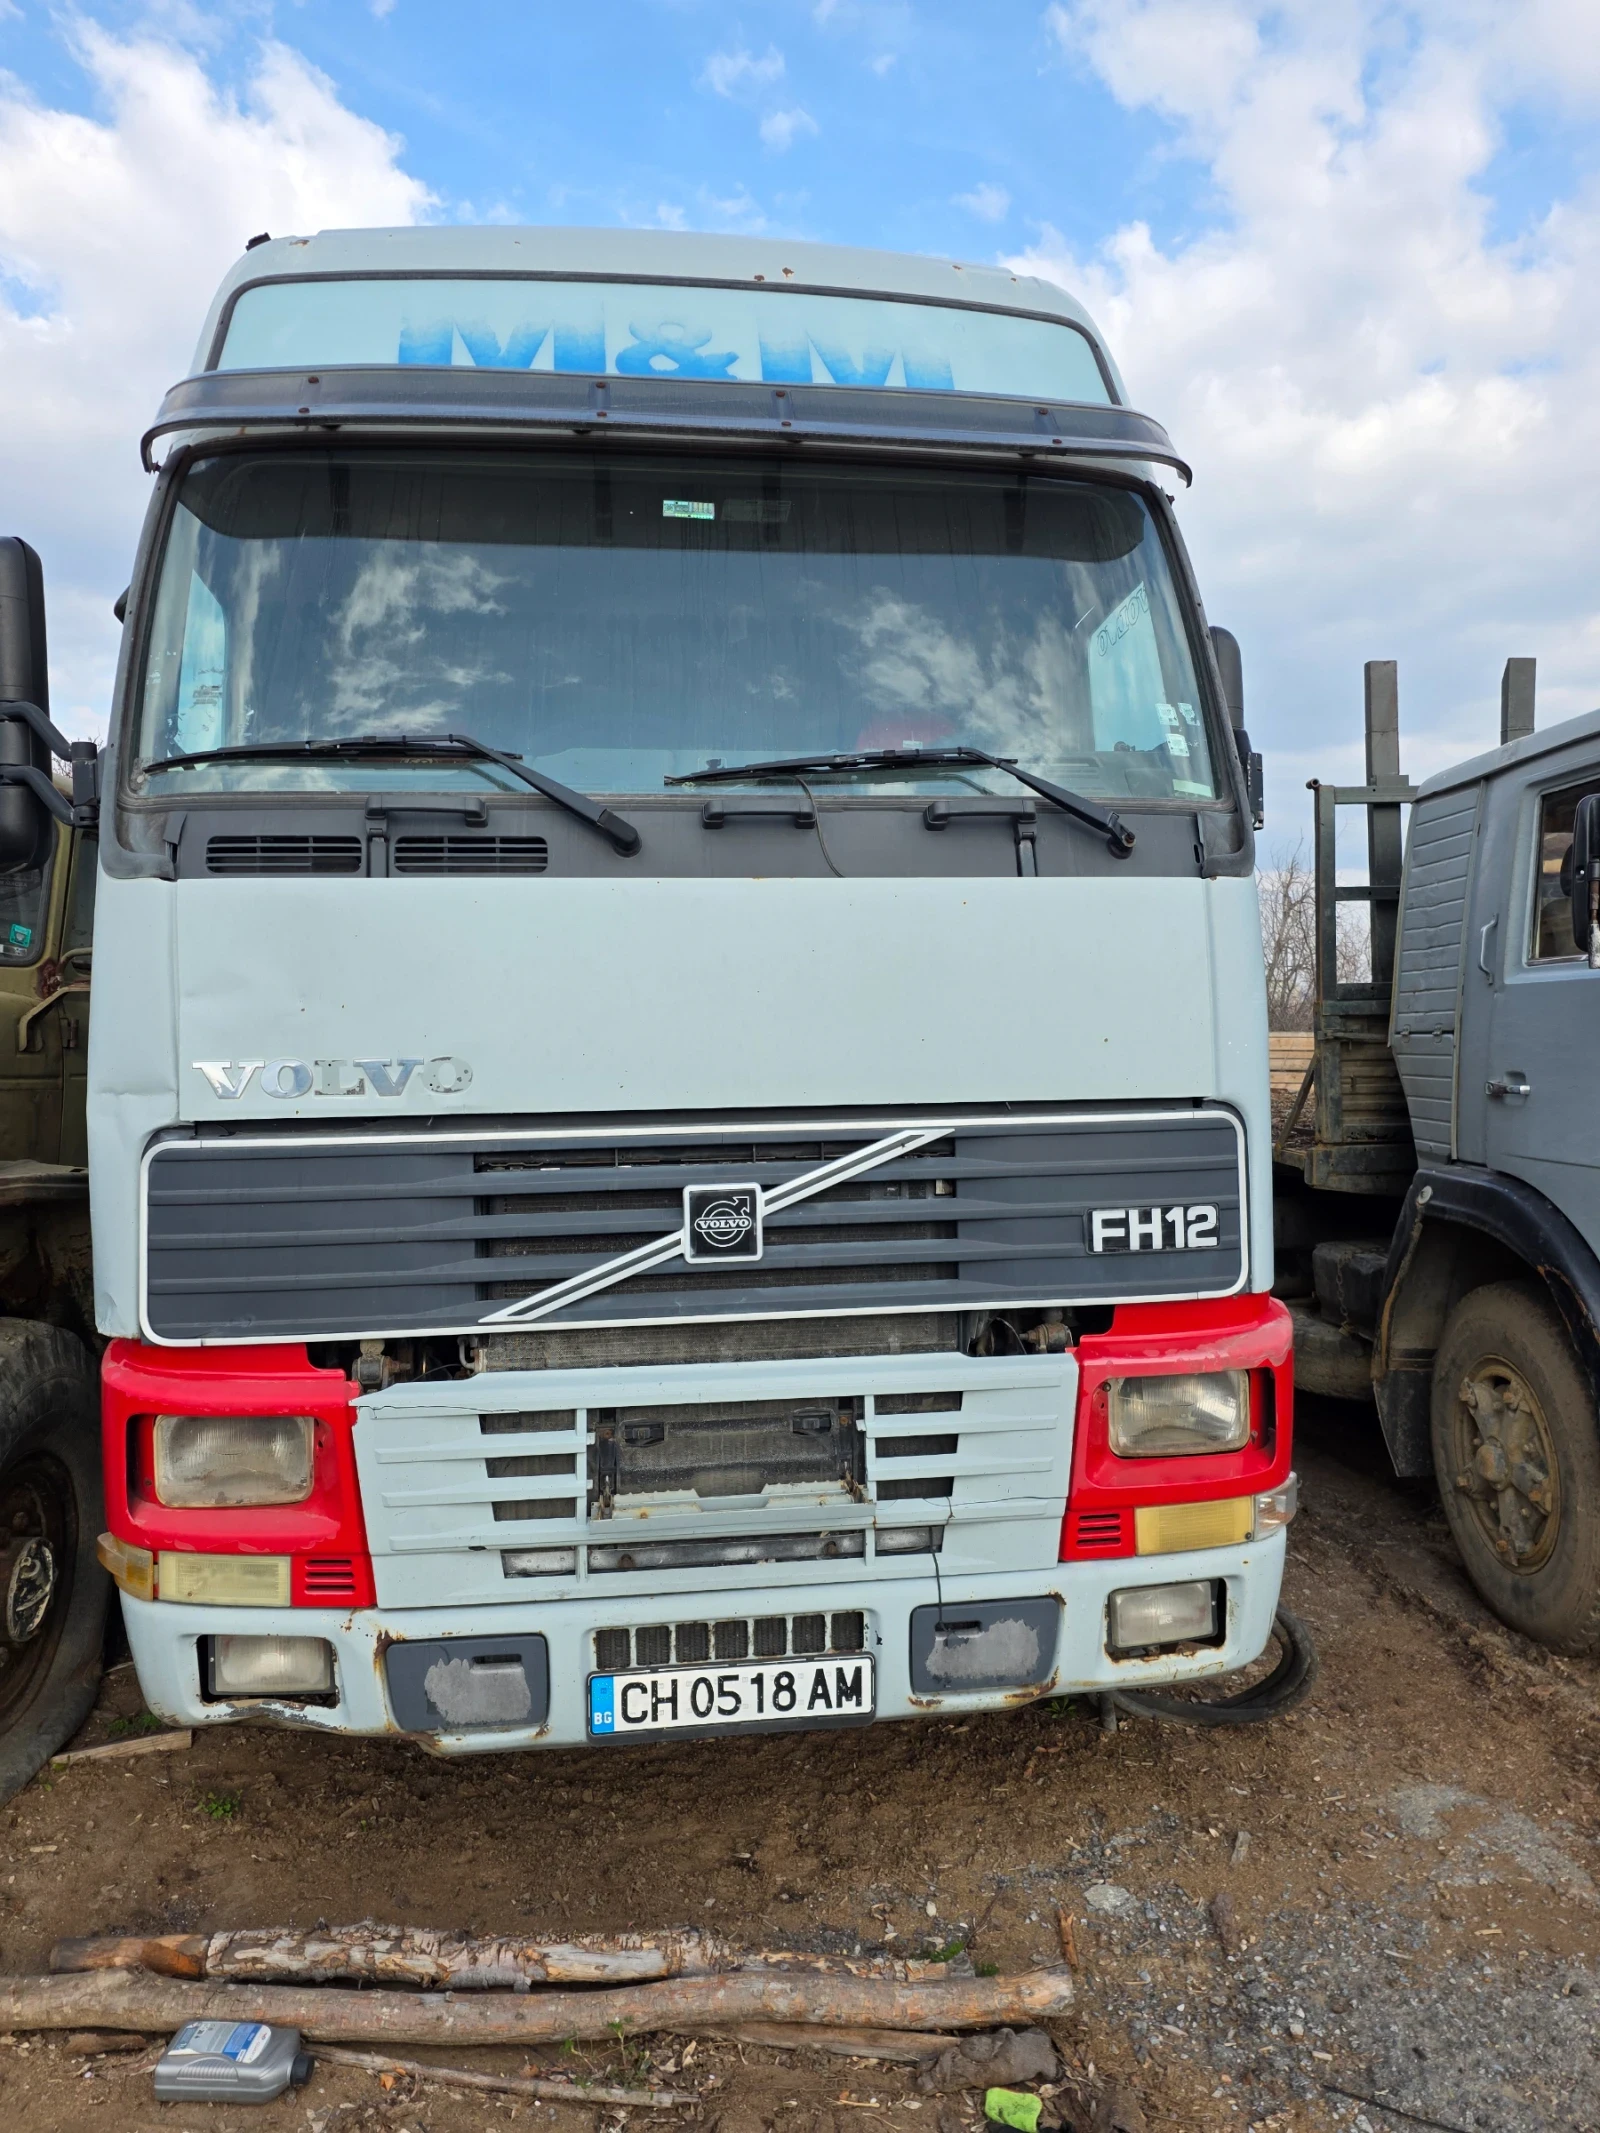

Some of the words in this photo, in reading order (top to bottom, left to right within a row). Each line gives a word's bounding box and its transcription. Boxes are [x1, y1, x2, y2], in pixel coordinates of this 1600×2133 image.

[398, 306, 956, 391] M&M
[192, 1056, 474, 1099] VOLVO
[697, 1218, 749, 1229] VOLVO
[1092, 1205, 1218, 1252] FH12
[621, 1678, 678, 1724] CH
[690, 1671, 797, 1718] 0518
[807, 1665, 862, 1711] AM
[594, 1711, 613, 1725] BG
